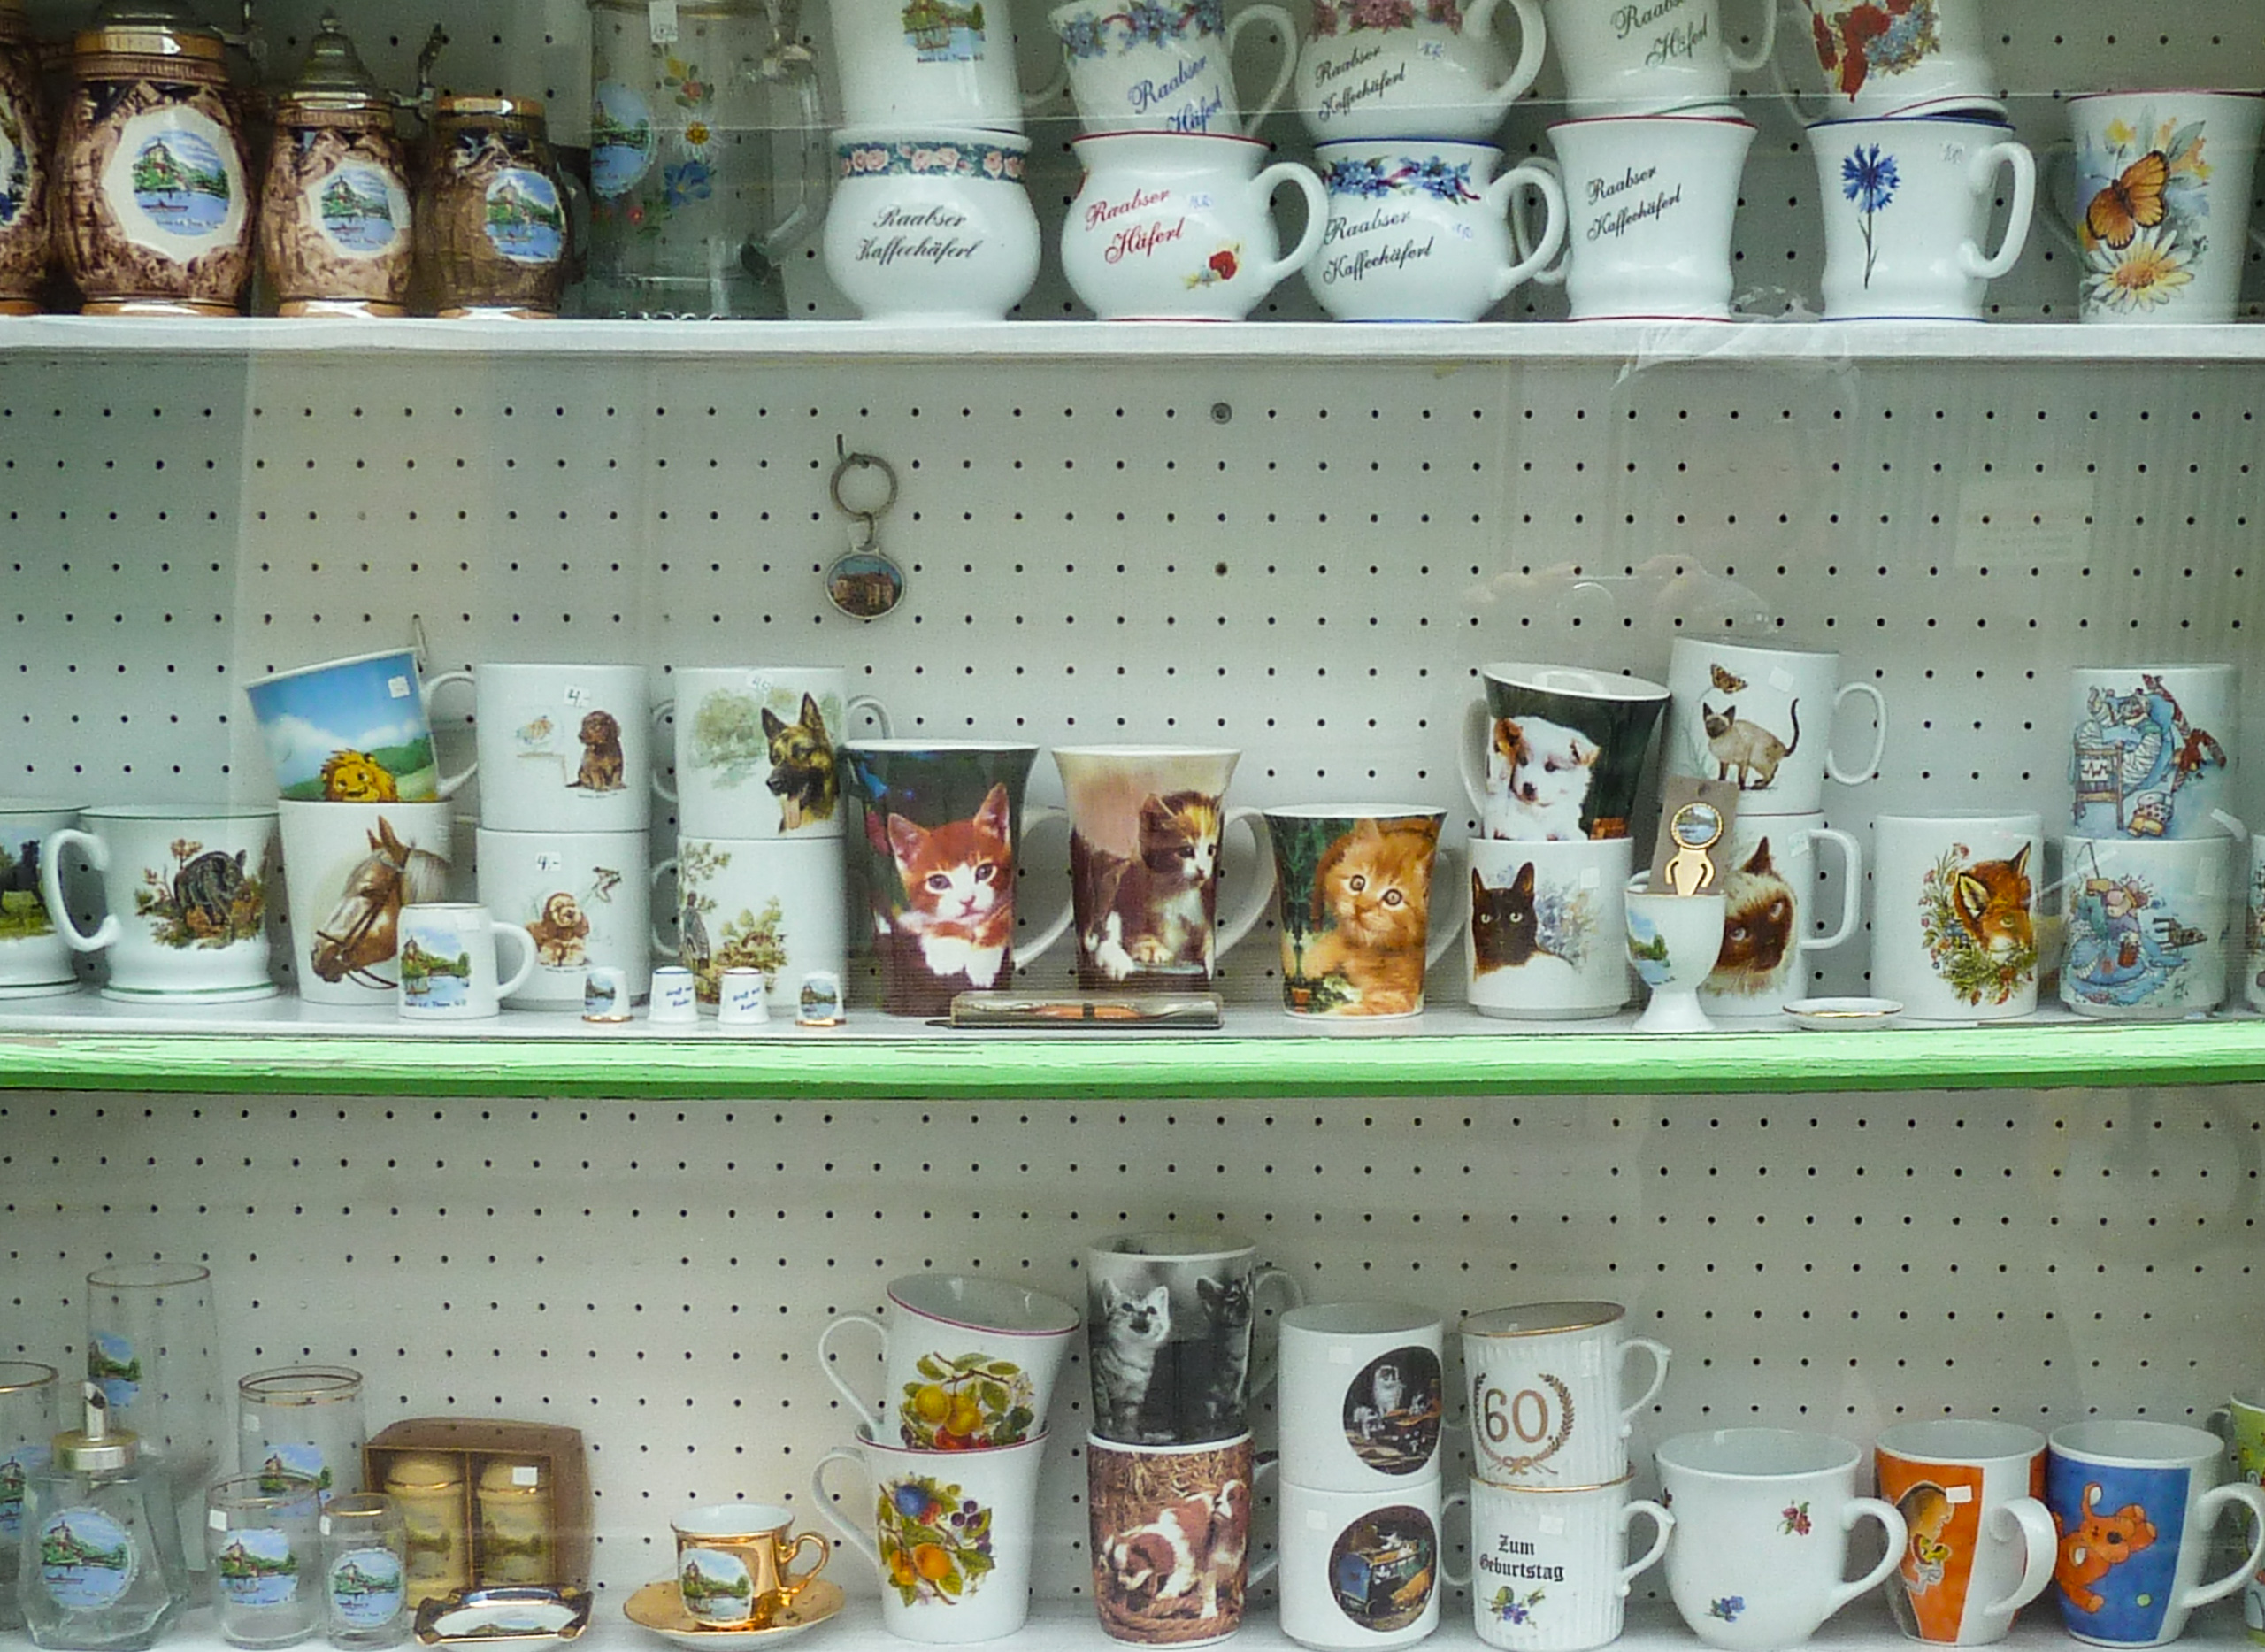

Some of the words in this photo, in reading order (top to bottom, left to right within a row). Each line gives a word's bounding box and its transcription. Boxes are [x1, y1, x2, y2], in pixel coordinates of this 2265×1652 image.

[1128, 56, 1207, 114] Raabser
[1315, 46, 1380, 88] Raabser
[1586, 166, 1656, 205] Raabser
[872, 204, 966, 228] Raabser
[1086, 188, 1170, 232] Raabser
[1324, 208, 1410, 245] Raabser
[1587, 183, 1682, 241] Kaffeehäferl
[856, 236, 983, 265] Kaffeehäferl
[1104, 217, 1185, 264] Häferl
[1323, 236, 1434, 284] Kaffeehäferl
[1485, 1388, 1548, 1443] 60
[1498, 1534, 1535, 1556] Zum
[1479, 1554, 1564, 1582] Geburtstag
